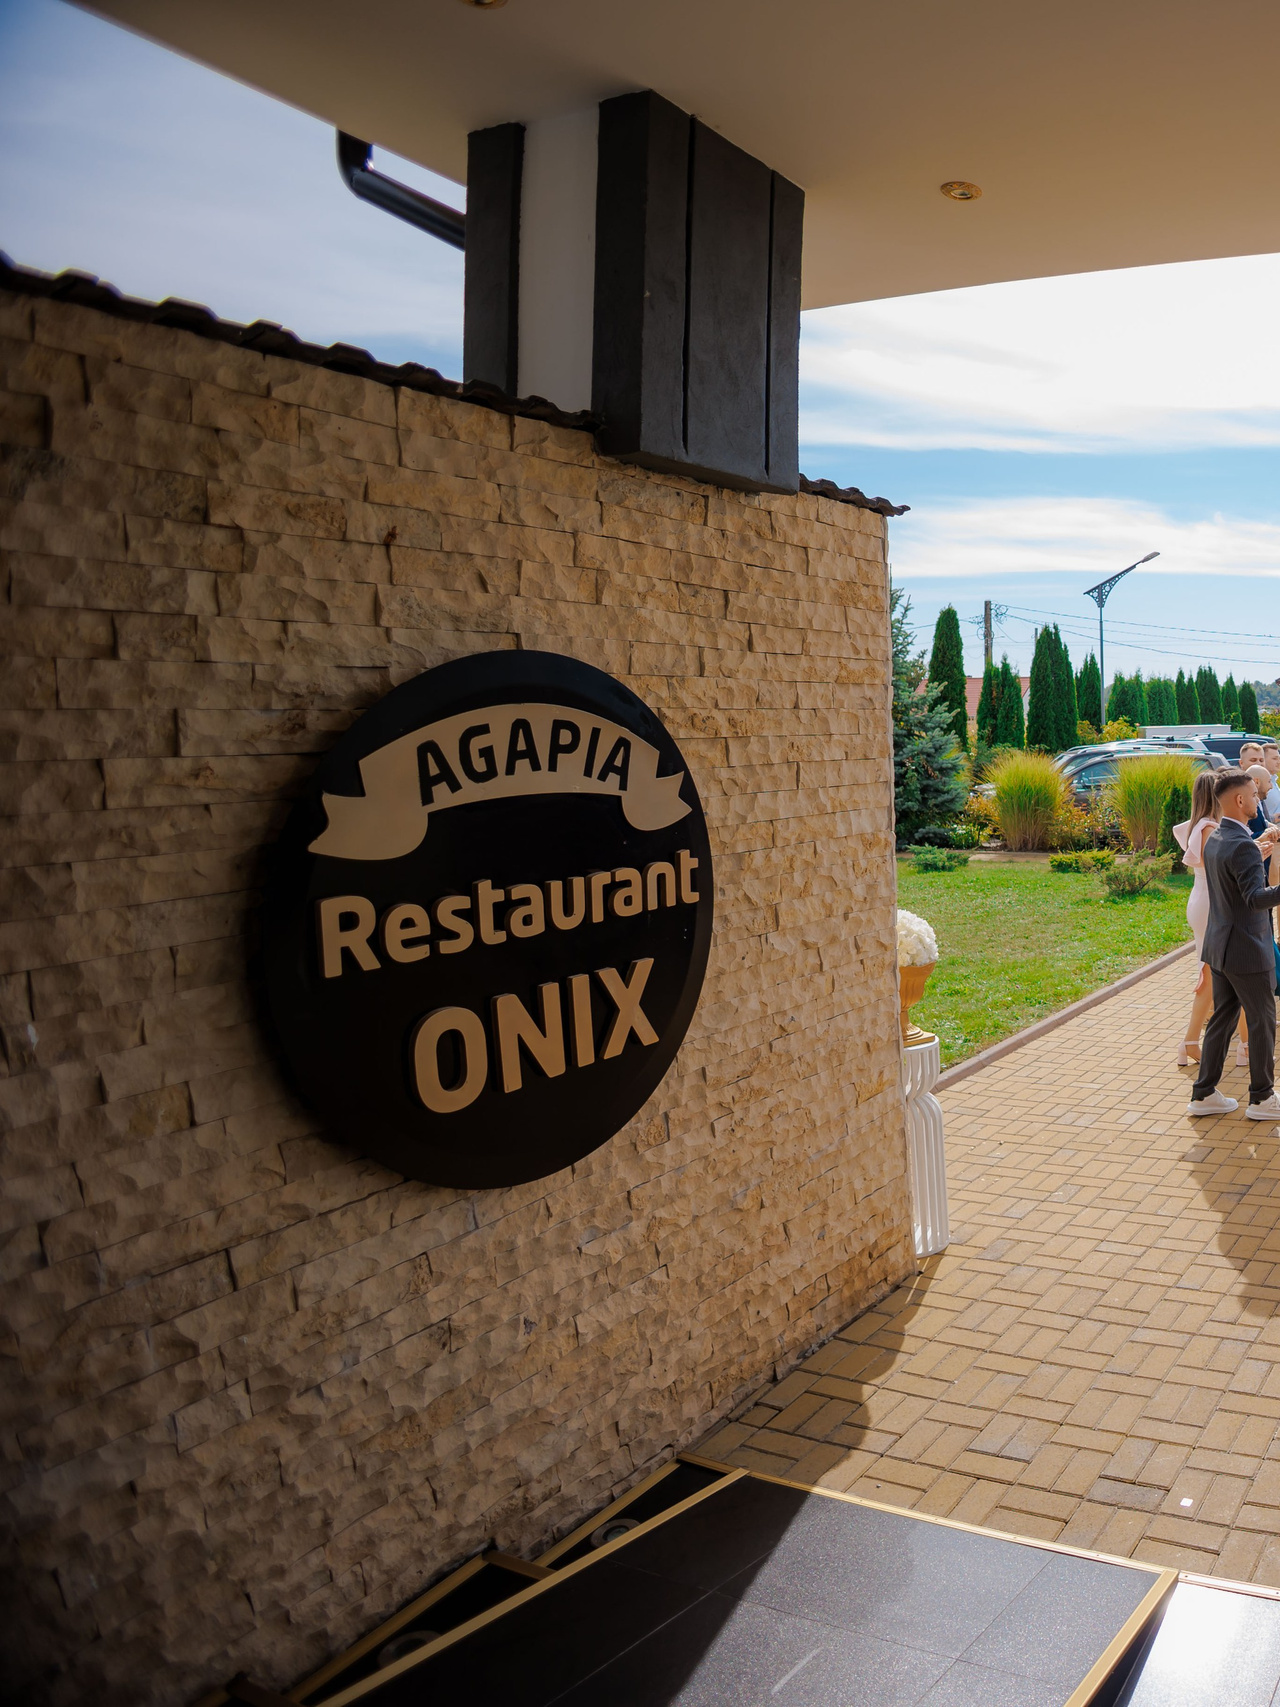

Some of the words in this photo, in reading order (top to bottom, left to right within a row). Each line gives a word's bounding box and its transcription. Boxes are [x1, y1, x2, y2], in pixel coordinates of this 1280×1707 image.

[416, 718, 633, 806] AGAPIA
[319, 849, 700, 978] Restaurant
[413, 957, 660, 1113] ONIX
